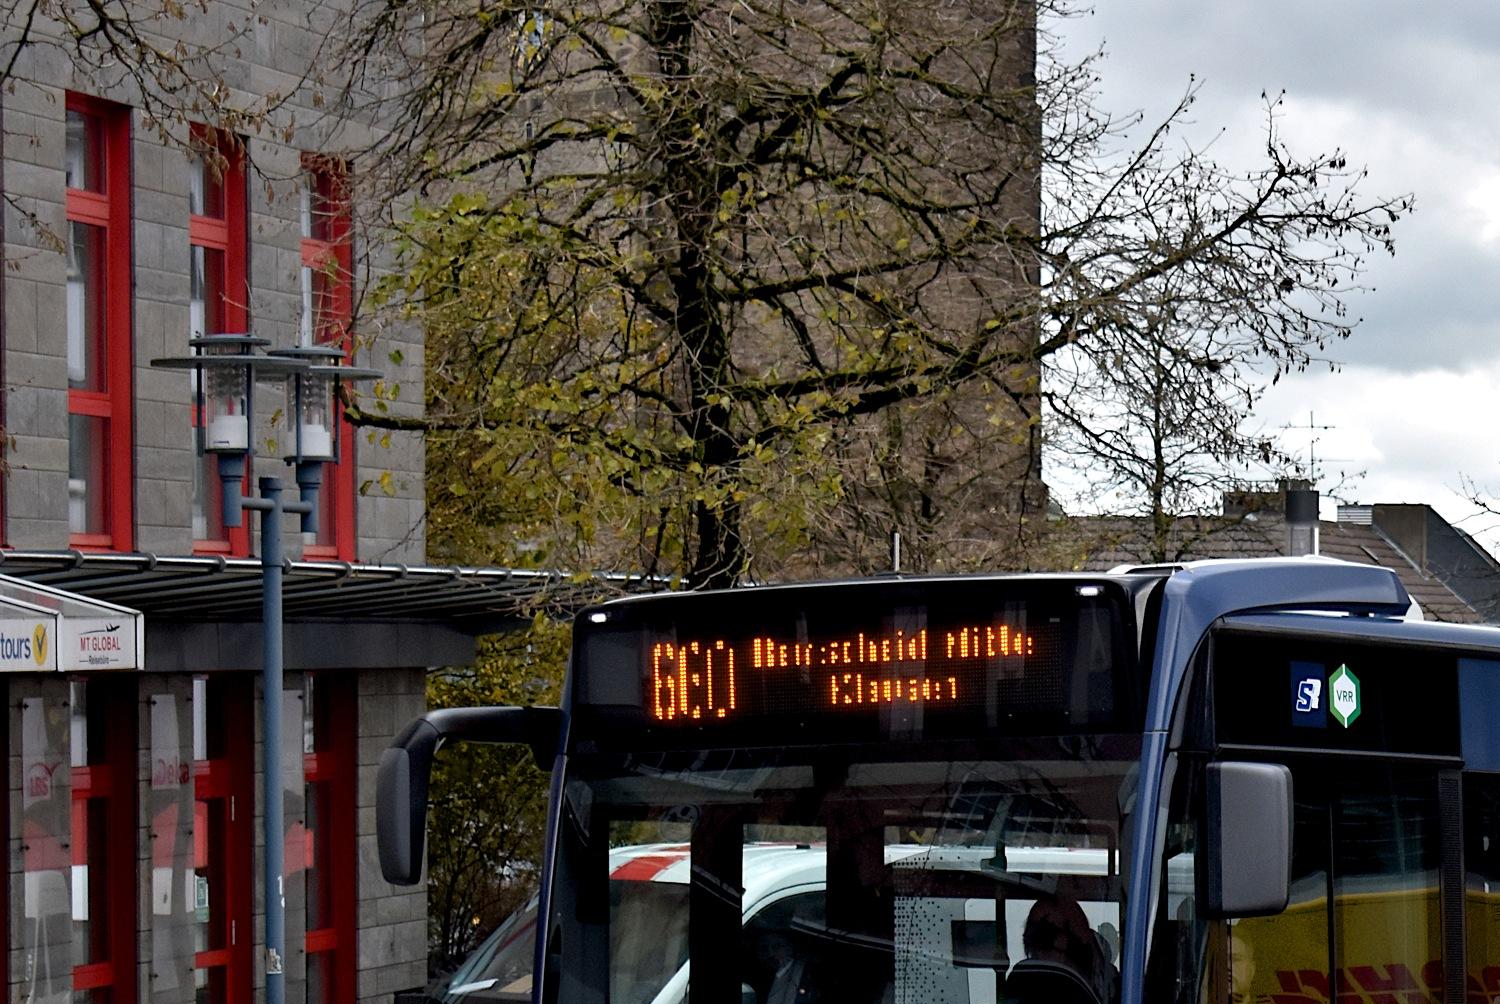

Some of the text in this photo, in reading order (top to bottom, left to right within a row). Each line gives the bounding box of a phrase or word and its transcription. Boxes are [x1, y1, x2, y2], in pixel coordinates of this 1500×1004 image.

[80, 637, 120, 651] MT GLOBAL
[1336, 690, 1354, 703] VRR
